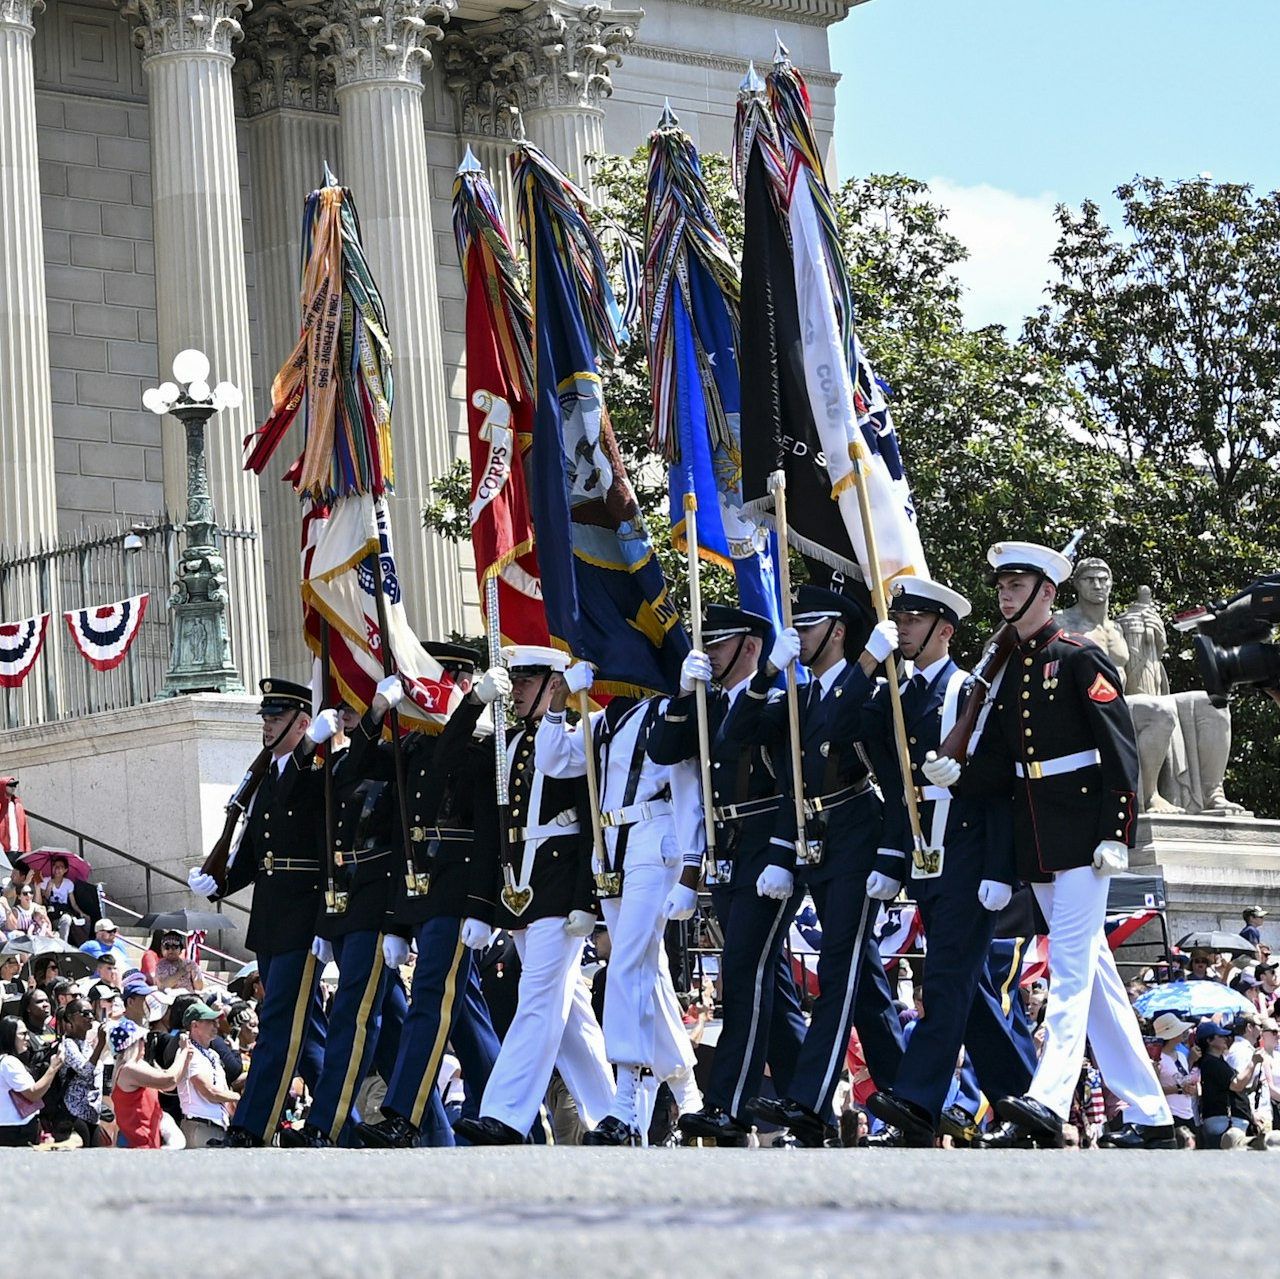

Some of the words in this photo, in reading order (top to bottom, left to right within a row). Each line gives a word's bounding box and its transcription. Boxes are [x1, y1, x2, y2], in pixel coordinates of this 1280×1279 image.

[327, 293, 339, 318] CHINA
[321, 320, 336, 364] OFFENSIVE
[317, 367, 330, 388] 1945
[478, 446, 507, 500] CORPS
